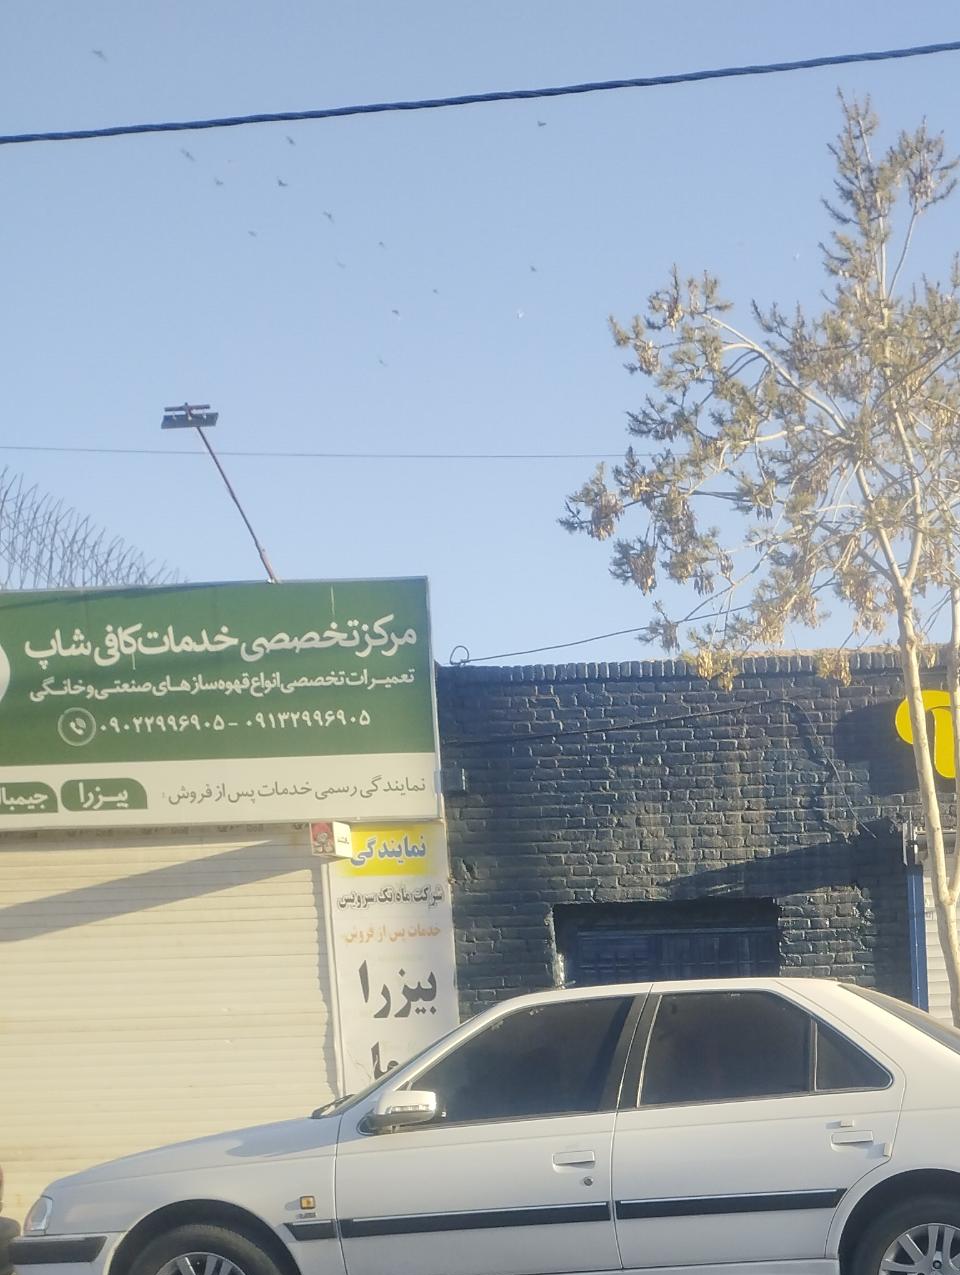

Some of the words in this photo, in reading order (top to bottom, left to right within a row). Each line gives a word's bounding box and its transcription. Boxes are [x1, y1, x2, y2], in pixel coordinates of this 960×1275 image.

[93, 623, 143, 666] کافی
[138, 625, 239, 655] خدمات
[240, 619, 361, 662] تخصصی
[355, 614, 417, 657] مرکز
[24, 628, 92, 670] شاپ
[30, 677, 86, 702] خانگی
[94, 680, 152, 700] صنعتی
[250, 671, 281, 697] انواع
[281, 670, 345, 694] تخصصی
[346, 668, 415, 690] تعمیرات
[0, 786, 48, 811] جیمبا
[215, 783, 226, 802] از
[228, 787, 255, 804] پس
[257, 781, 313, 798] خدمات
[314, 785, 358, 801] رسمی
[359, 774, 426, 799] نمایندگی
[350, 834, 427, 867] نمایندگی
[358, 960, 438, 1019] بیزرا
